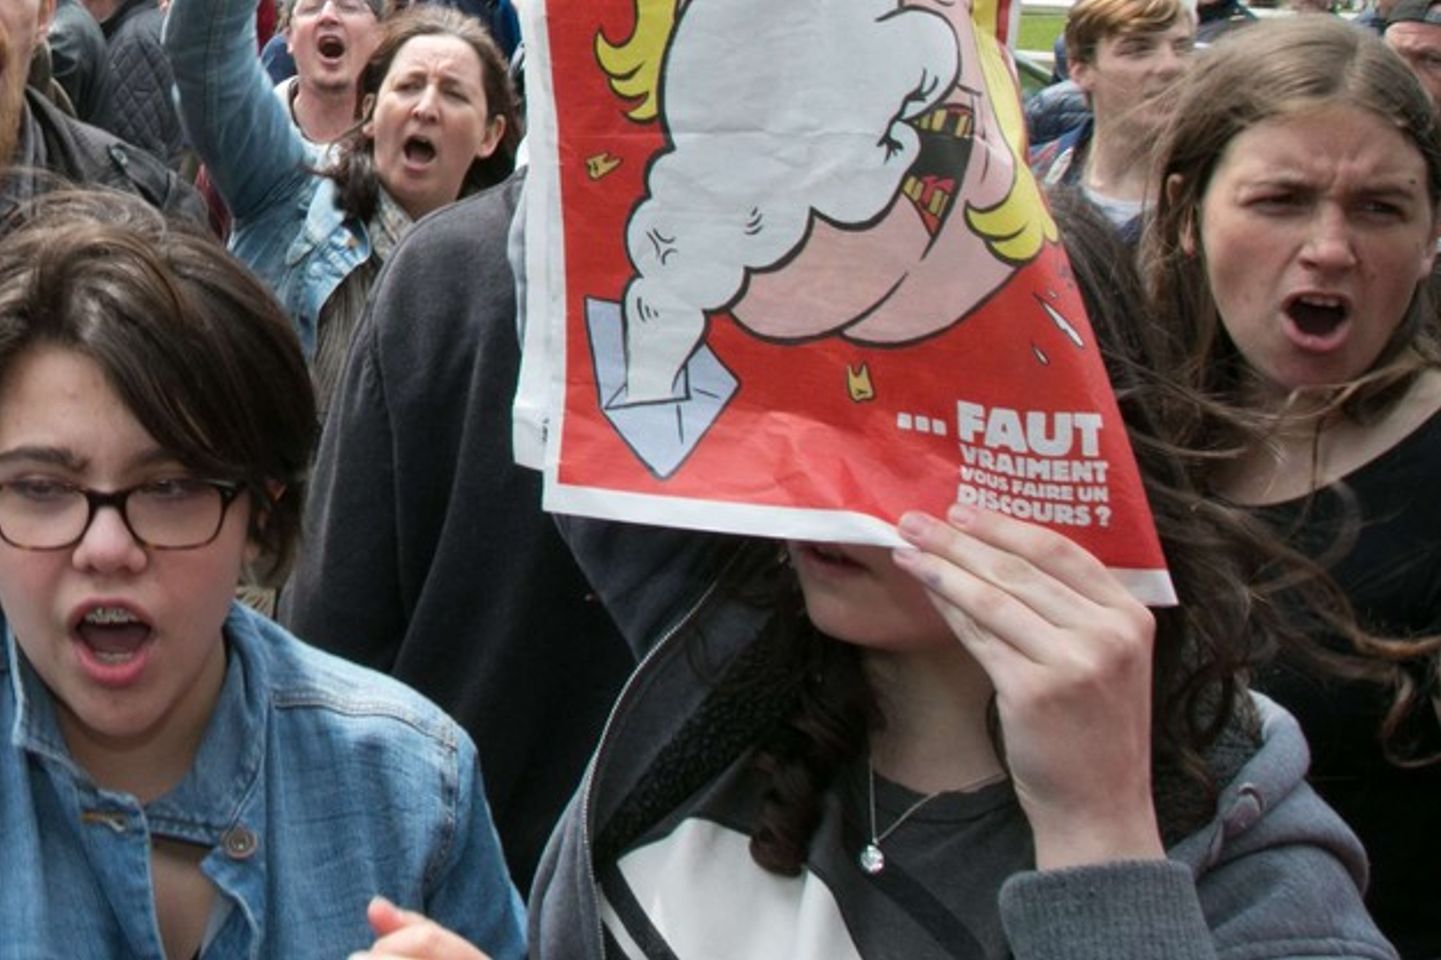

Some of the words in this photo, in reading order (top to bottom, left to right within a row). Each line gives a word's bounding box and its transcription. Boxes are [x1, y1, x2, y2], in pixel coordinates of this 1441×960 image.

[956, 399, 1104, 457] FAUT
[960, 442, 1109, 484] VRAIMENT
[960, 465, 1009, 492] VOUS
[1011, 479, 1074, 502] FAIRE
[1077, 486, 1110, 503] UN
[956, 483, 1092, 528] DISCOURS
